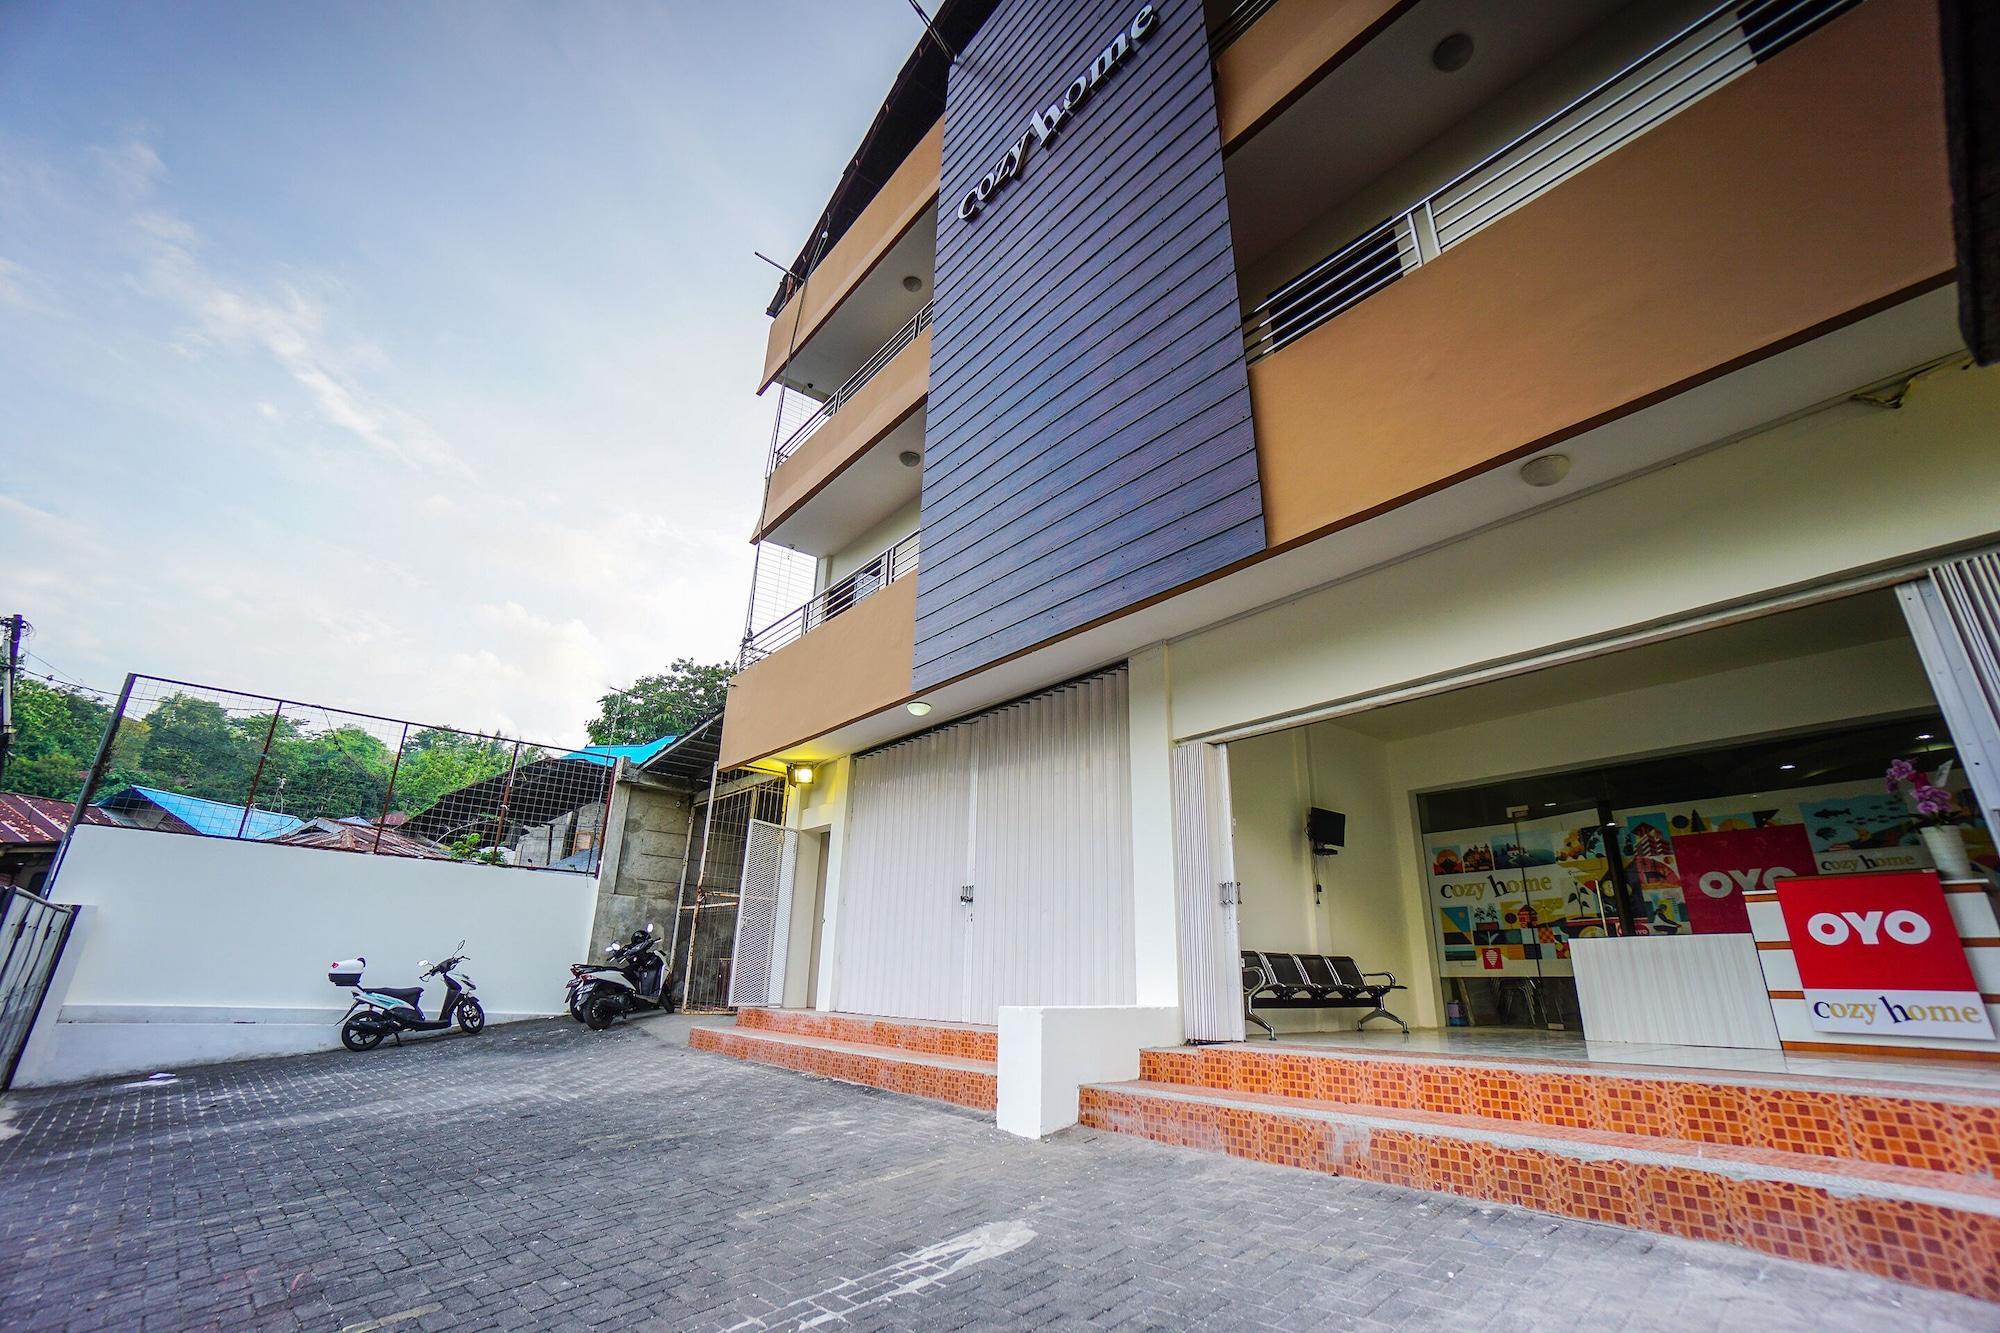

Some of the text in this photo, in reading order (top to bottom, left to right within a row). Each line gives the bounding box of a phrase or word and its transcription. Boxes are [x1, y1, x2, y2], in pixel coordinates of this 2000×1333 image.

[957, 4, 1157, 220] cozy home
[1821, 855, 1914, 872] cozy home
[1440, 874, 1552, 901] cozy home
[1807, 910, 1931, 946] OYO
[1814, 996, 1982, 1025] cozy home
